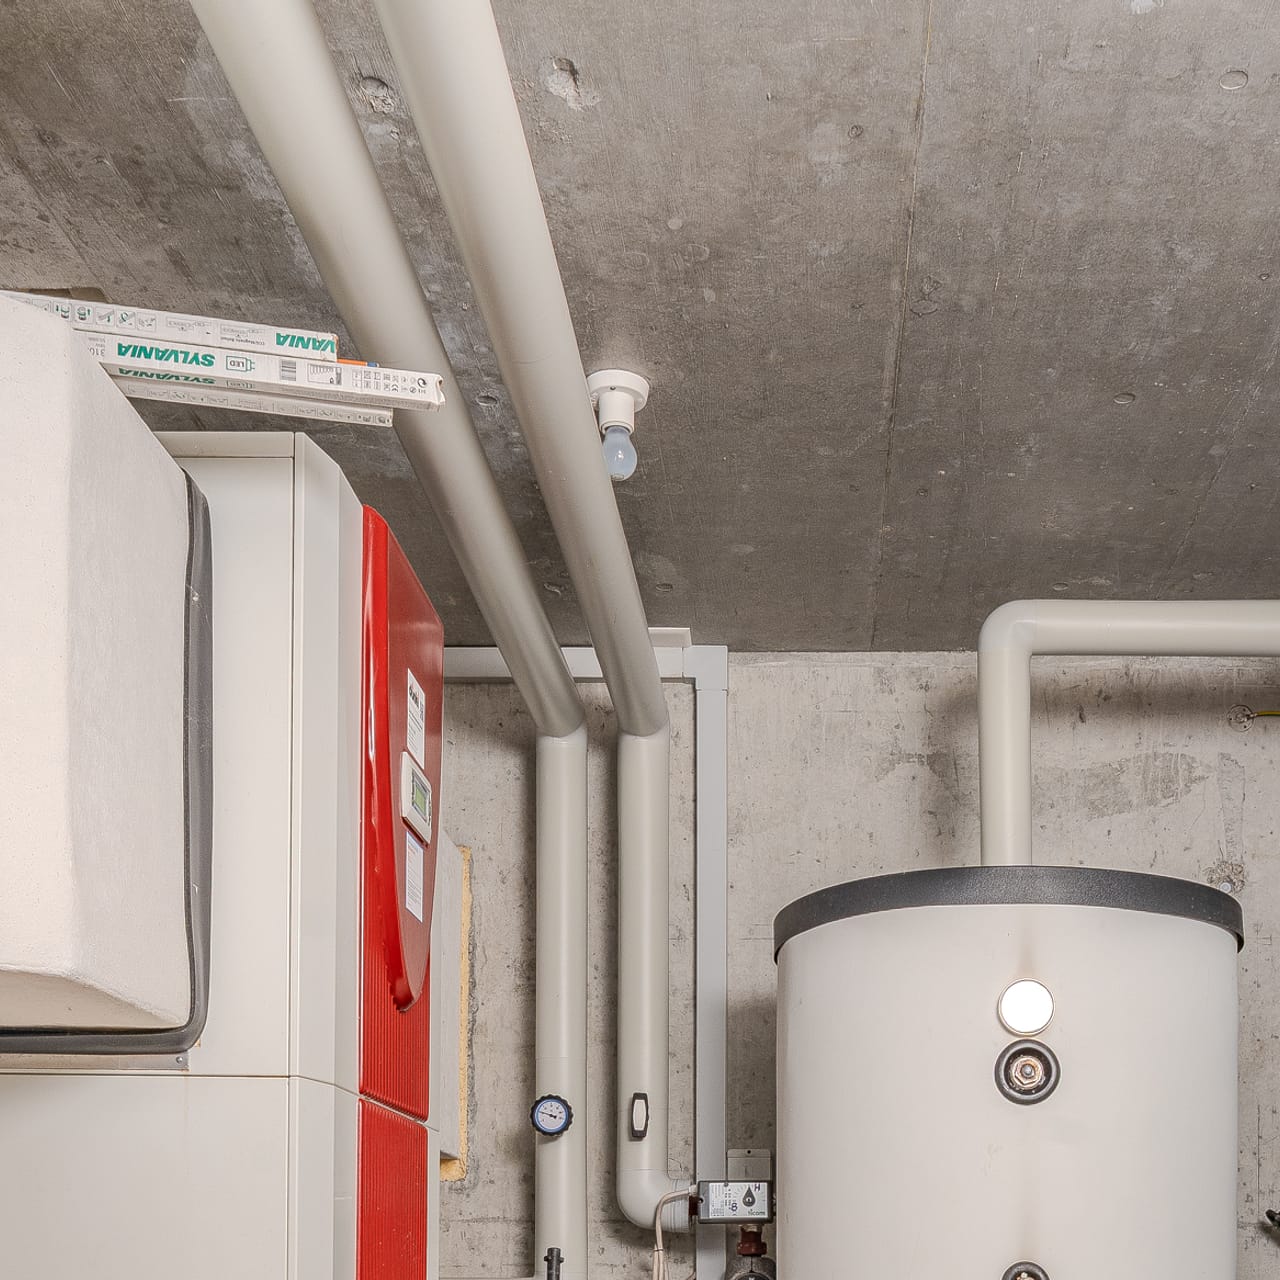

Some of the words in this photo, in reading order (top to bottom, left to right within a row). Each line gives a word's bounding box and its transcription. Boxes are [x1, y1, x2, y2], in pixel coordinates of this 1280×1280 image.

[275, 332, 336, 353] VANIA
[117, 342, 216, 367] SYLVANIA
[229, 360, 246, 368] LED
[118, 367, 217, 385] SYLVANIA
